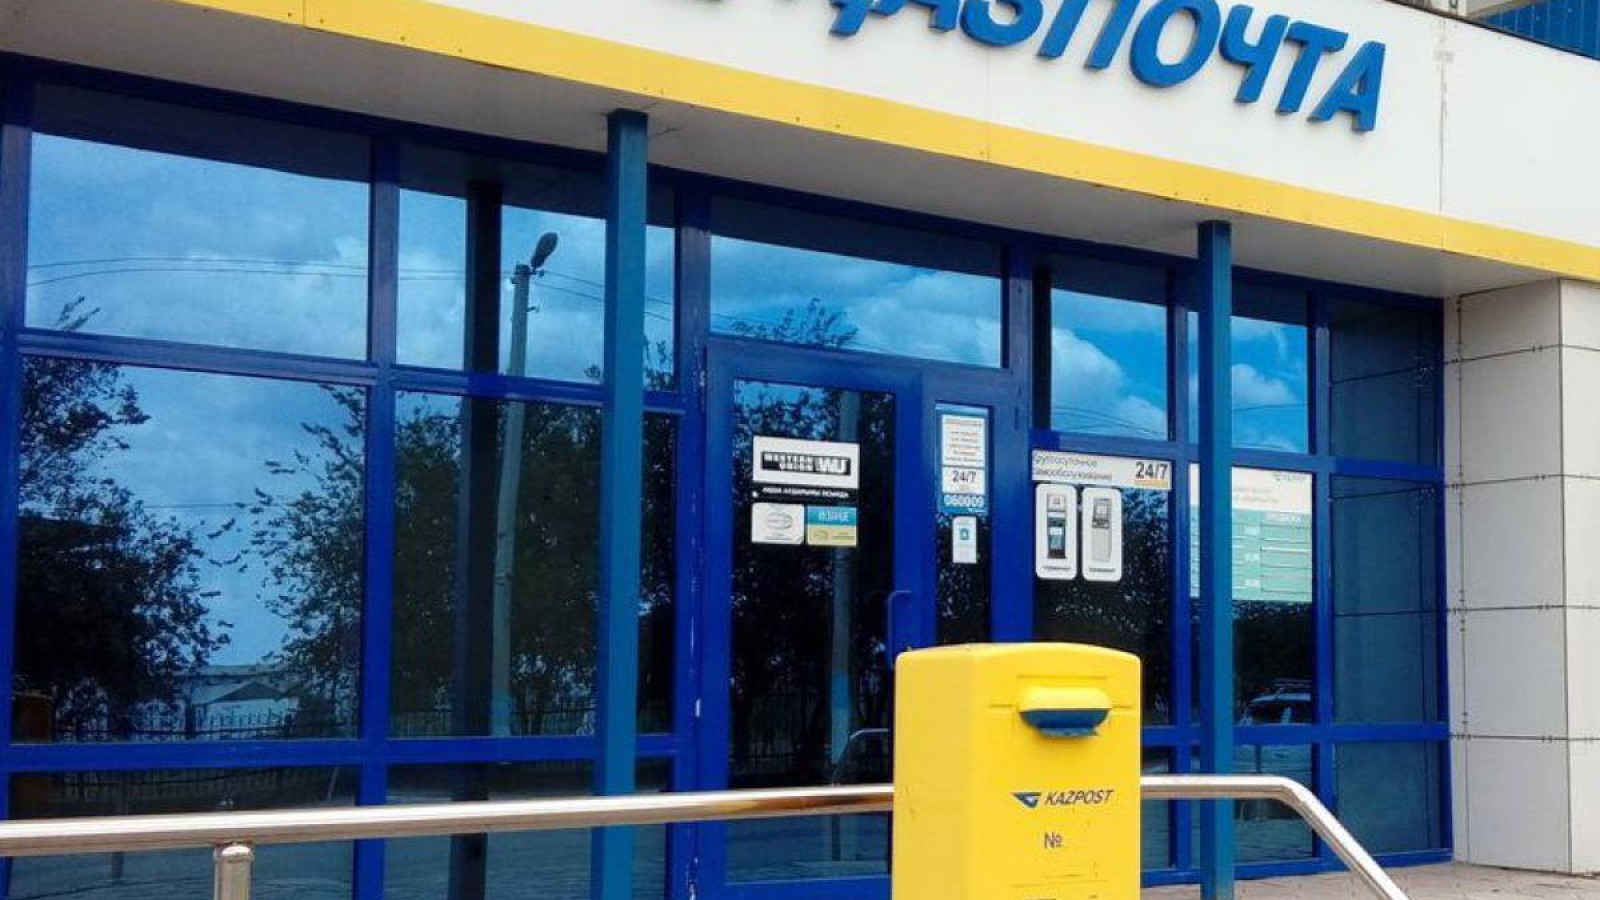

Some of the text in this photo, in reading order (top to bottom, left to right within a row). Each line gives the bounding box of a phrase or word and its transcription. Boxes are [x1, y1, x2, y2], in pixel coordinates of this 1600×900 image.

[951, 470, 977, 483] 24/7
[1135, 462, 1169, 479] 24/7
[1044, 789, 1114, 806] KAZPOST
[1044, 832, 1063, 849] №
